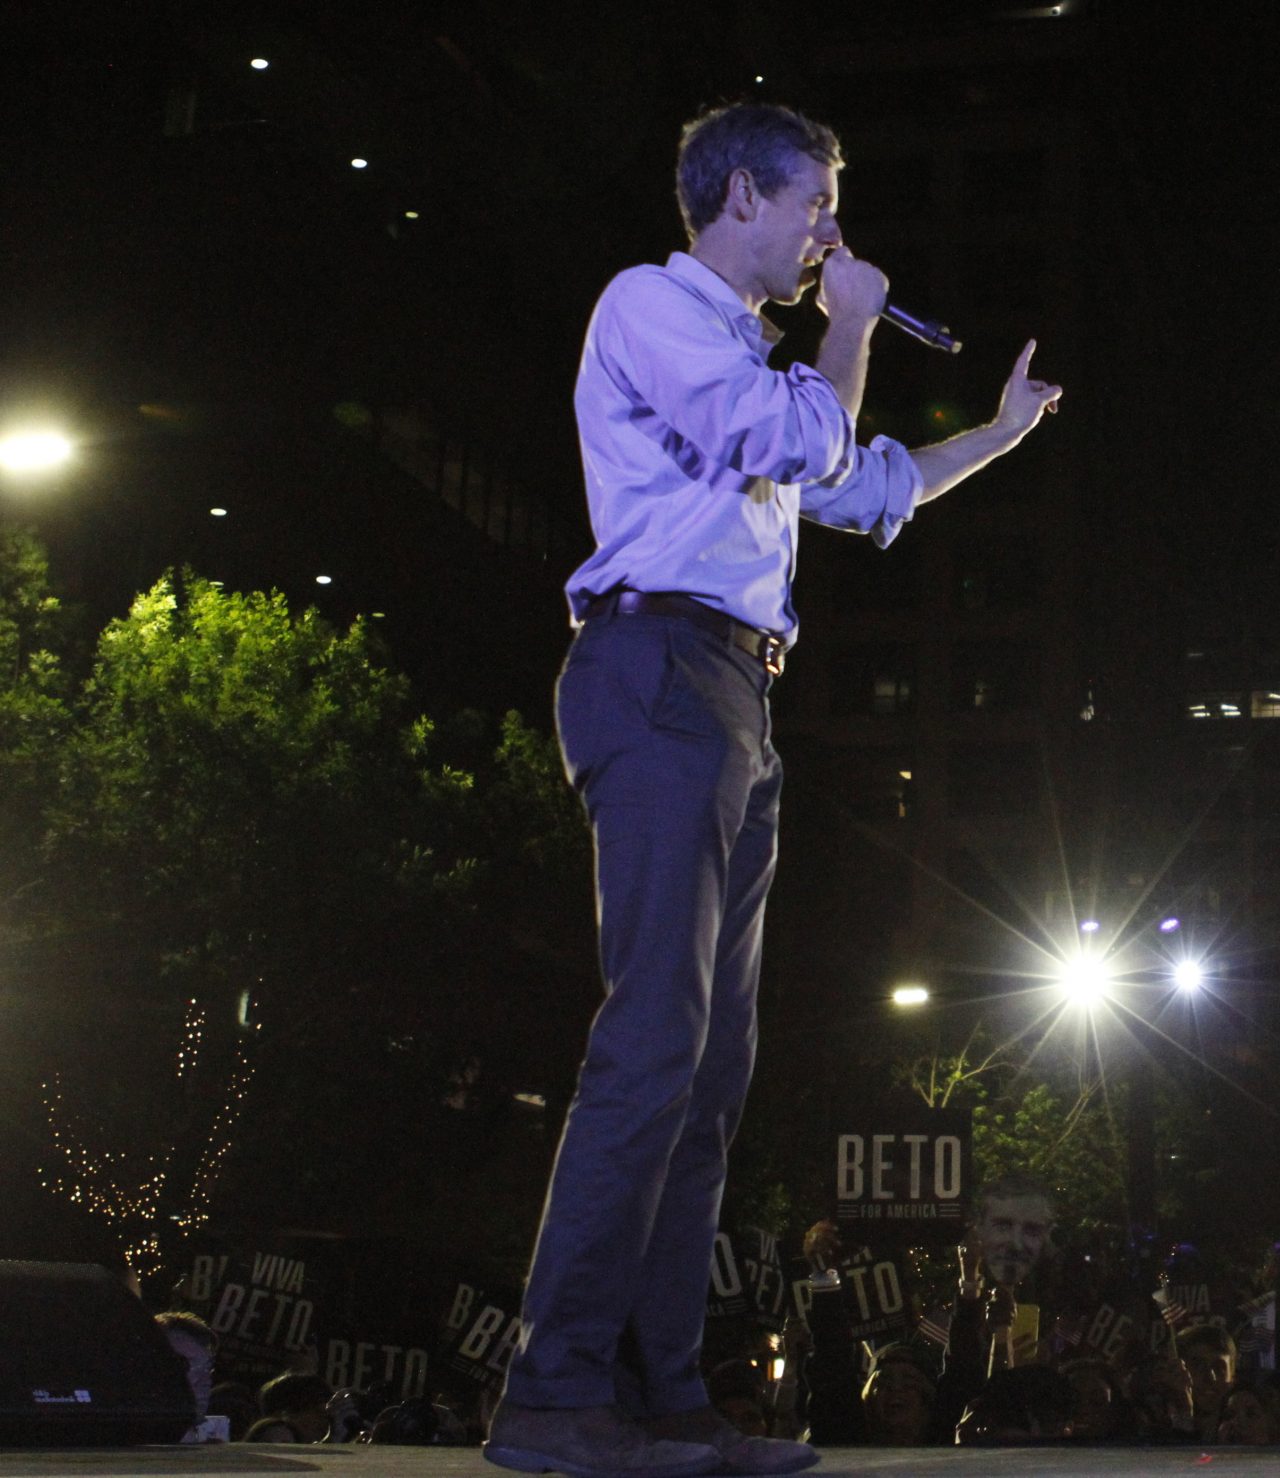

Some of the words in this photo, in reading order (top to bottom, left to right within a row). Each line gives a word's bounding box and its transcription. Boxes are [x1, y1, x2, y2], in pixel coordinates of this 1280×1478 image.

[837, 1134, 961, 1199] BETO
[861, 1204, 881, 1218] FOR
[887, 1204, 937, 1218] AMERICA
[251, 1251, 305, 1294] VIVA
[210, 1283, 314, 1351] BETO
[325, 1338, 428, 1402] BETO
